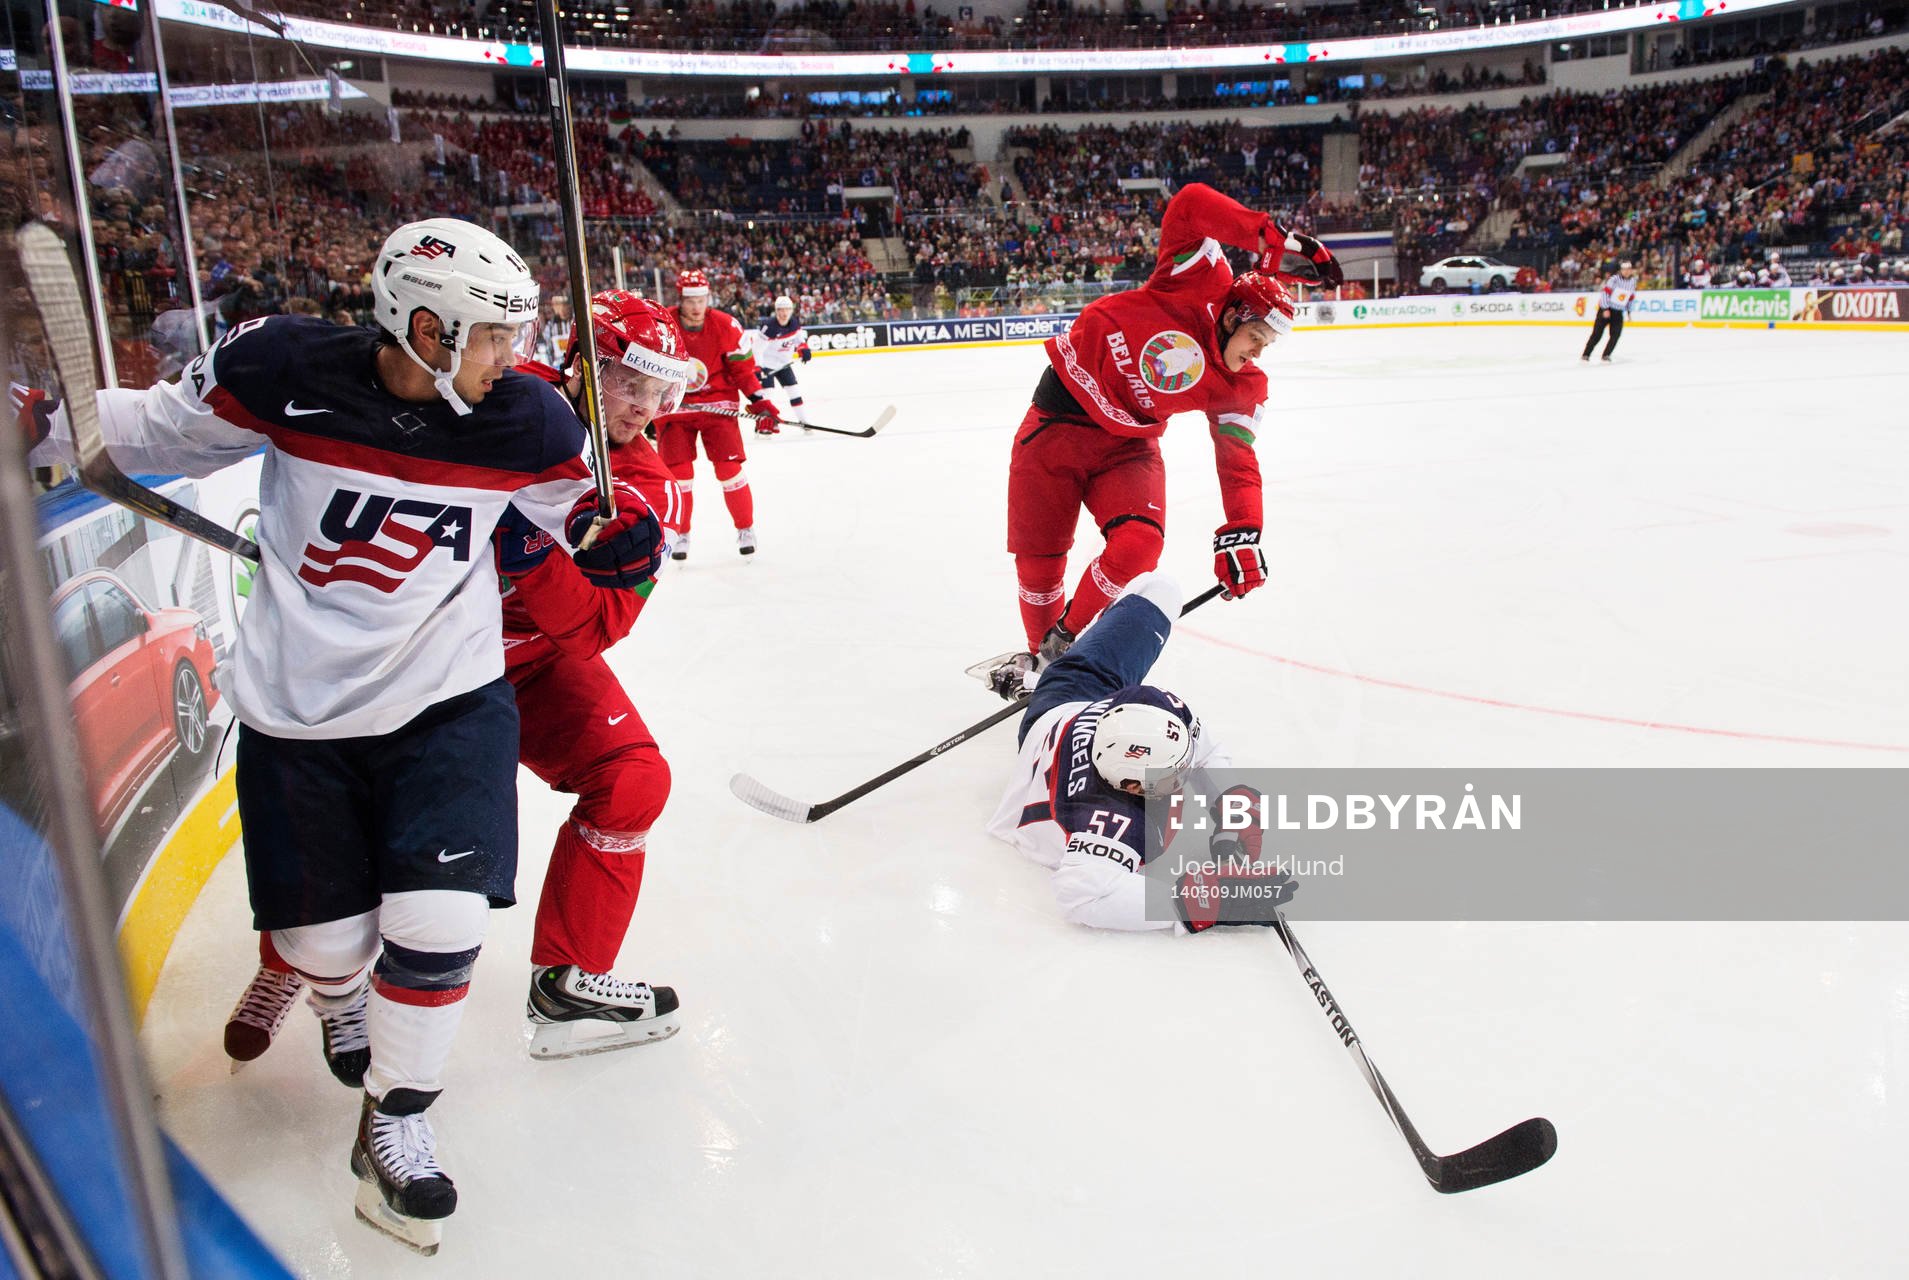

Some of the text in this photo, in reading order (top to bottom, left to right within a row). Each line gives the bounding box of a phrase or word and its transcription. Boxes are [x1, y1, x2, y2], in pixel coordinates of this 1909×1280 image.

[410, 235, 456, 260] USA
[401, 274, 443, 291] BAUER
[508, 295, 539, 313] ŠKO
[1631, 299, 1697, 312] TADLER
[1729, 294, 1791, 319] Actavis
[806, 325, 876, 350] eresit
[893, 321, 1001, 344] NIVEA MEN
[1106, 331, 1156, 410] BELARUS
[663, 480, 683, 525] 11
[298, 488, 472, 593] USA
[937, 734, 965, 753] EASTON
[1166, 720, 1181, 742] 57
[1067, 698, 1114, 798] WINGELS
[1124, 744, 1151, 759] USA
[1086, 809, 1132, 842] 57
[1067, 837, 1135, 873] ŠKODA
[1302, 967, 1355, 1048] EASTON
